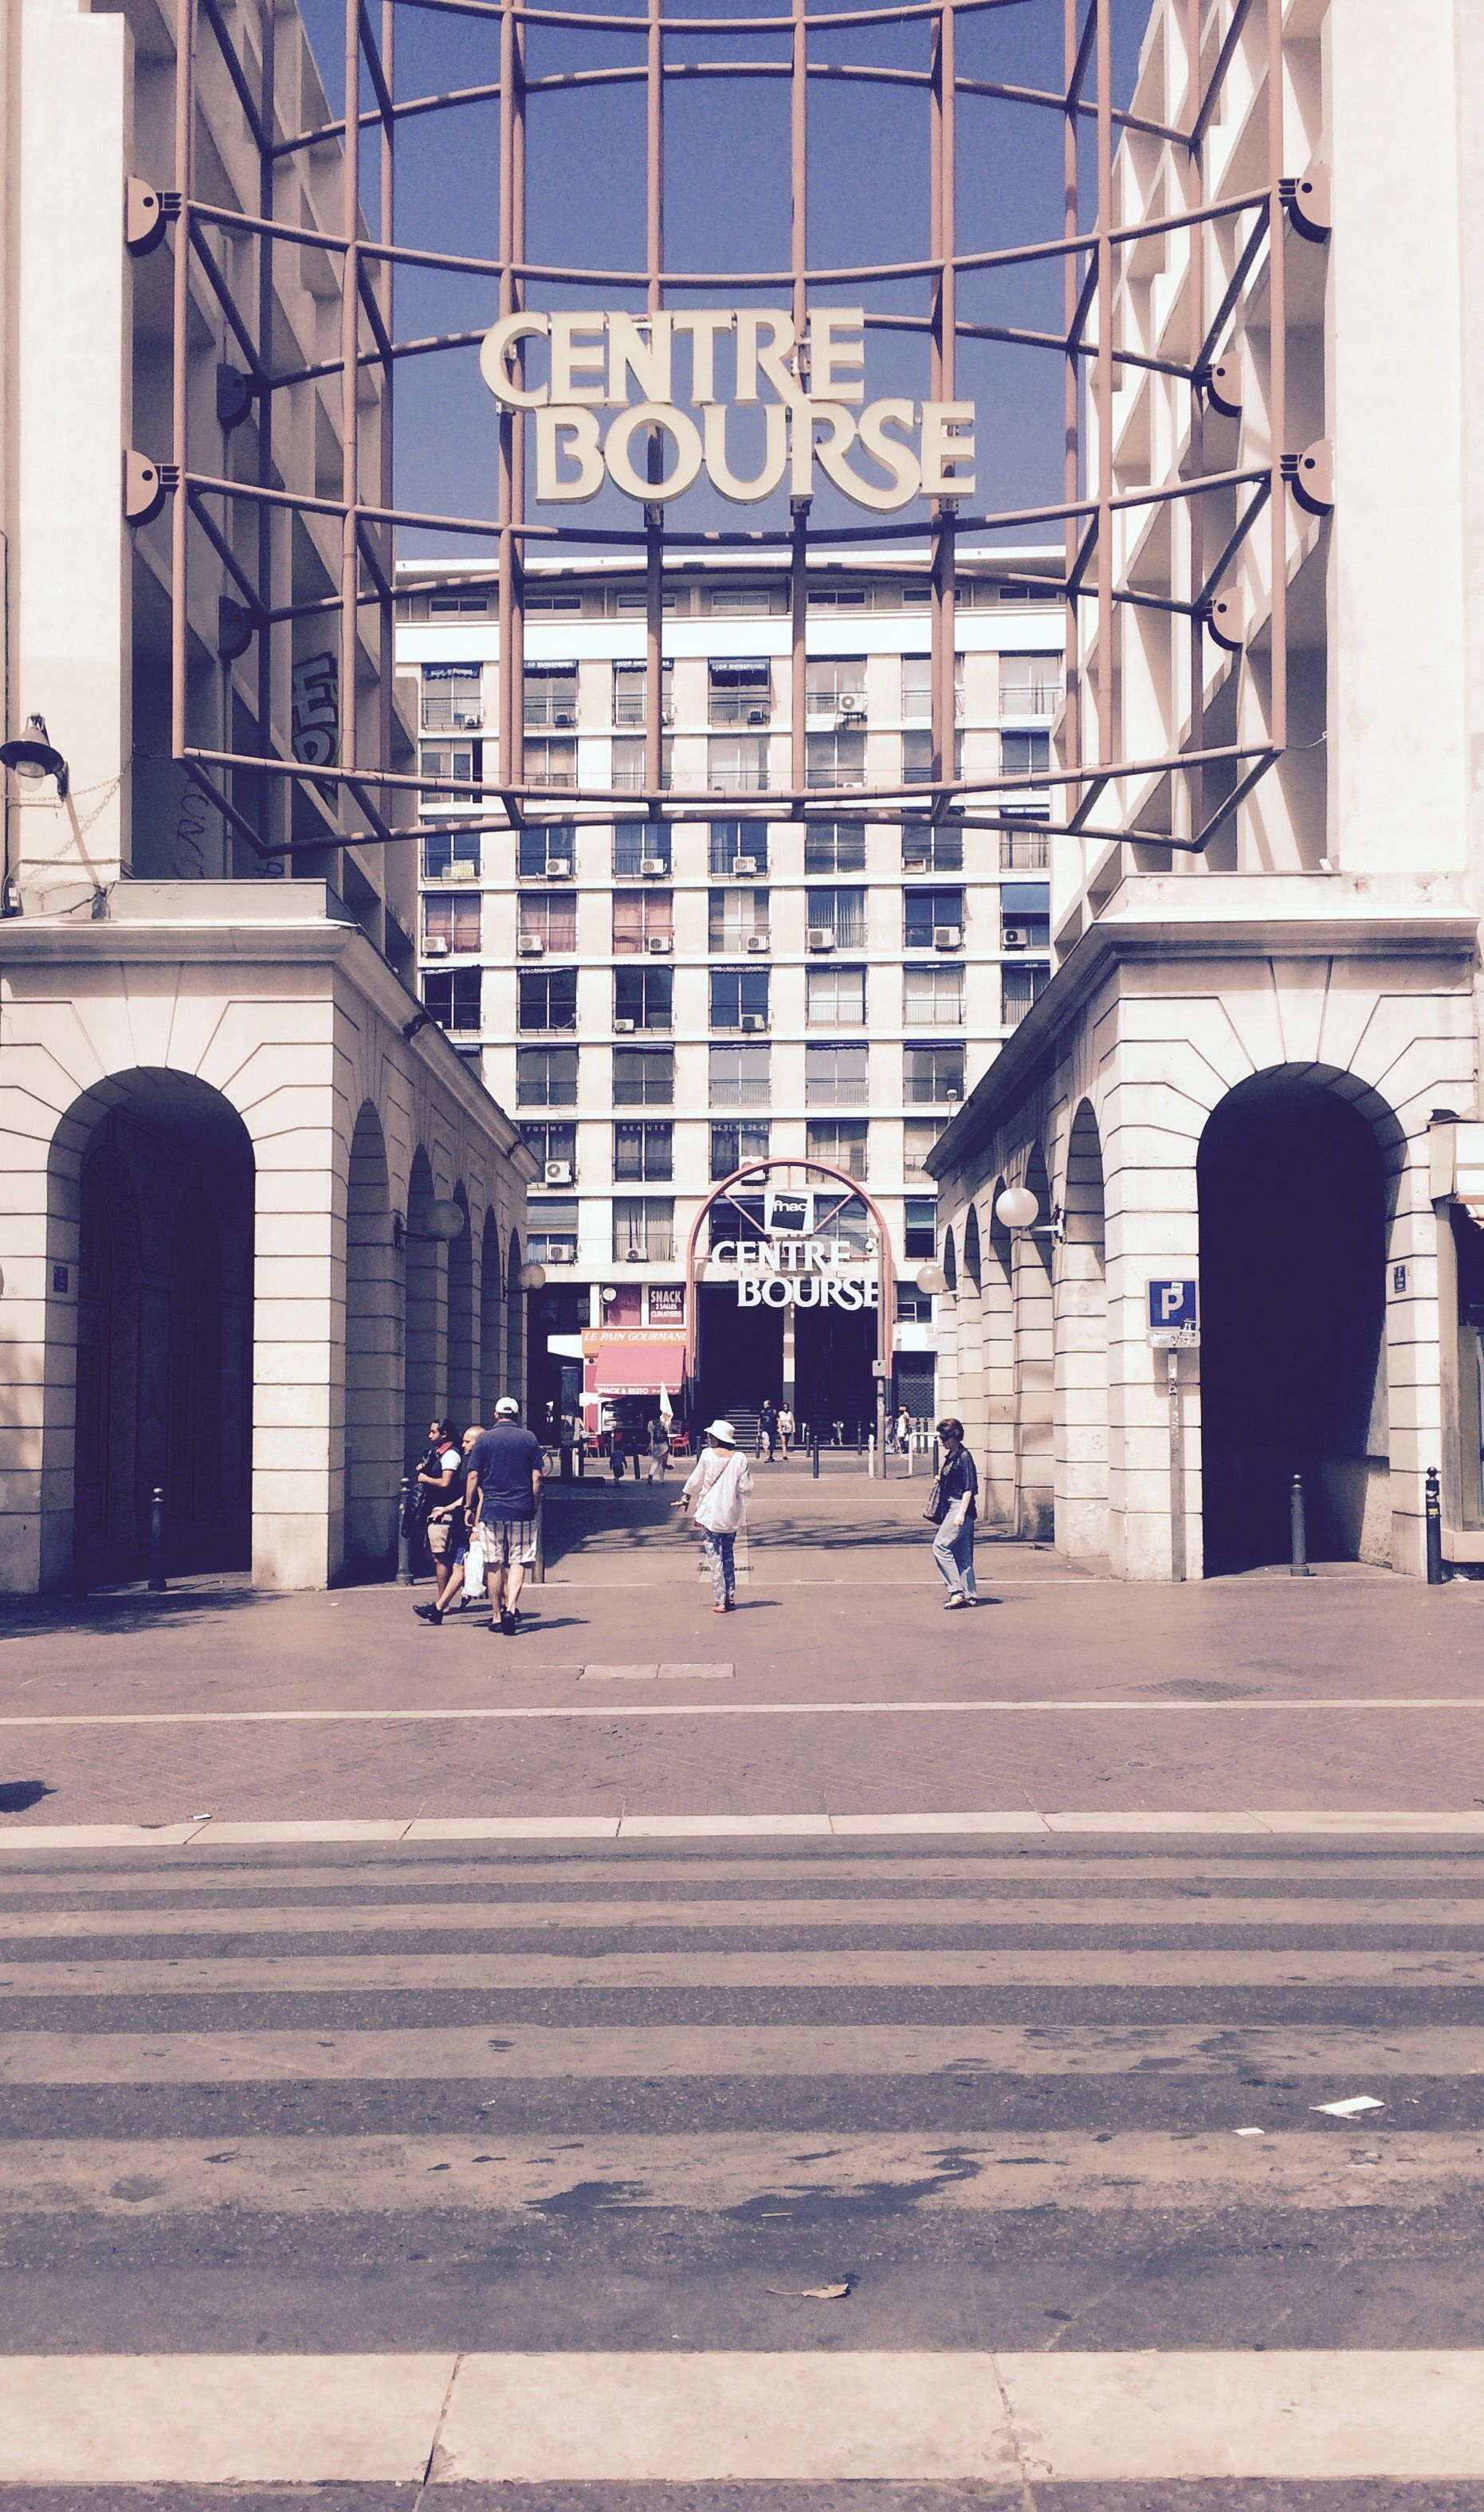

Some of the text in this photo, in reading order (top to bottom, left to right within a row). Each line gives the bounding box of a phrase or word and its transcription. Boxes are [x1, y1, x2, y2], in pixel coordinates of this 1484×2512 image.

[480, 307, 865, 411] CENTRE
[535, 398, 976, 515] BOURSE
[773, 1200, 807, 1212] fnac
[711, 1240, 850, 1274] CENTRE
[650, 1290, 681, 1303] SNACK
[736, 1276, 878, 1311] BOURSE
[1161, 1288, 1184, 1320] P
[584, 1332, 598, 1341] LE
[600, 1332, 624, 1341] PAIN
